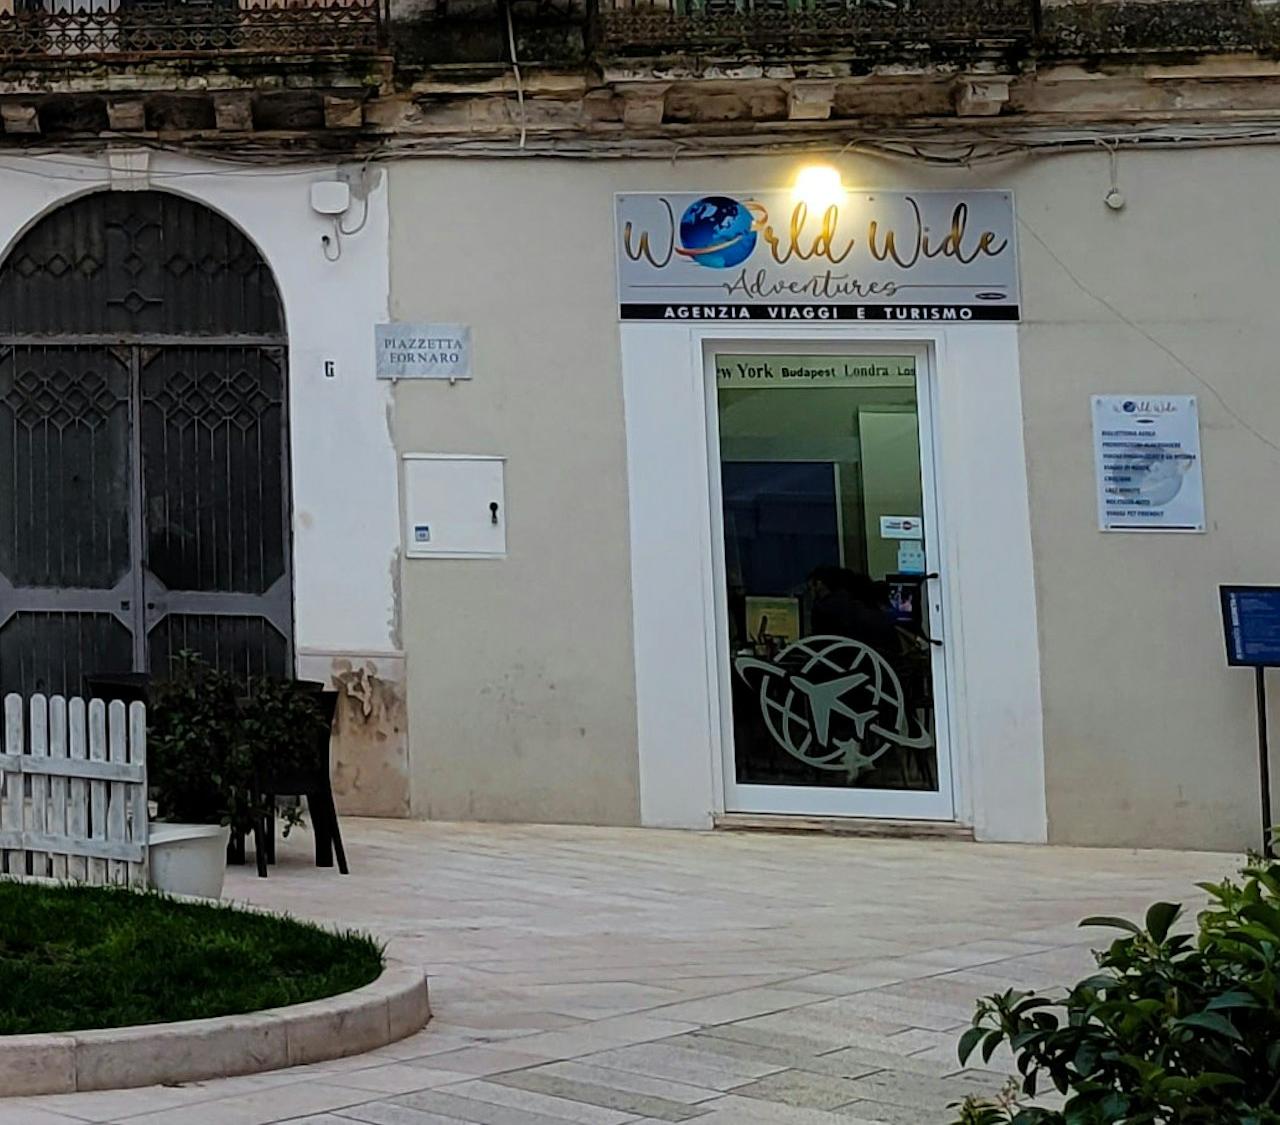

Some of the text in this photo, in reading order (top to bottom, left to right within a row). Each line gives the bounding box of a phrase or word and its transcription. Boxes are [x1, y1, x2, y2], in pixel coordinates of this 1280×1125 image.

[869, 196, 1008, 269] Wide
[722, 268, 903, 300] Adventures
[664, 306, 974, 321] AGENZIA VIAGGI E TURISMO
[384, 338, 463, 350] PIAZZETTA
[390, 352, 459, 364] FORNARO
[737, 363, 773, 379] York
[781, 367, 835, 381] Budapest
[844, 364, 888, 378] Londra
